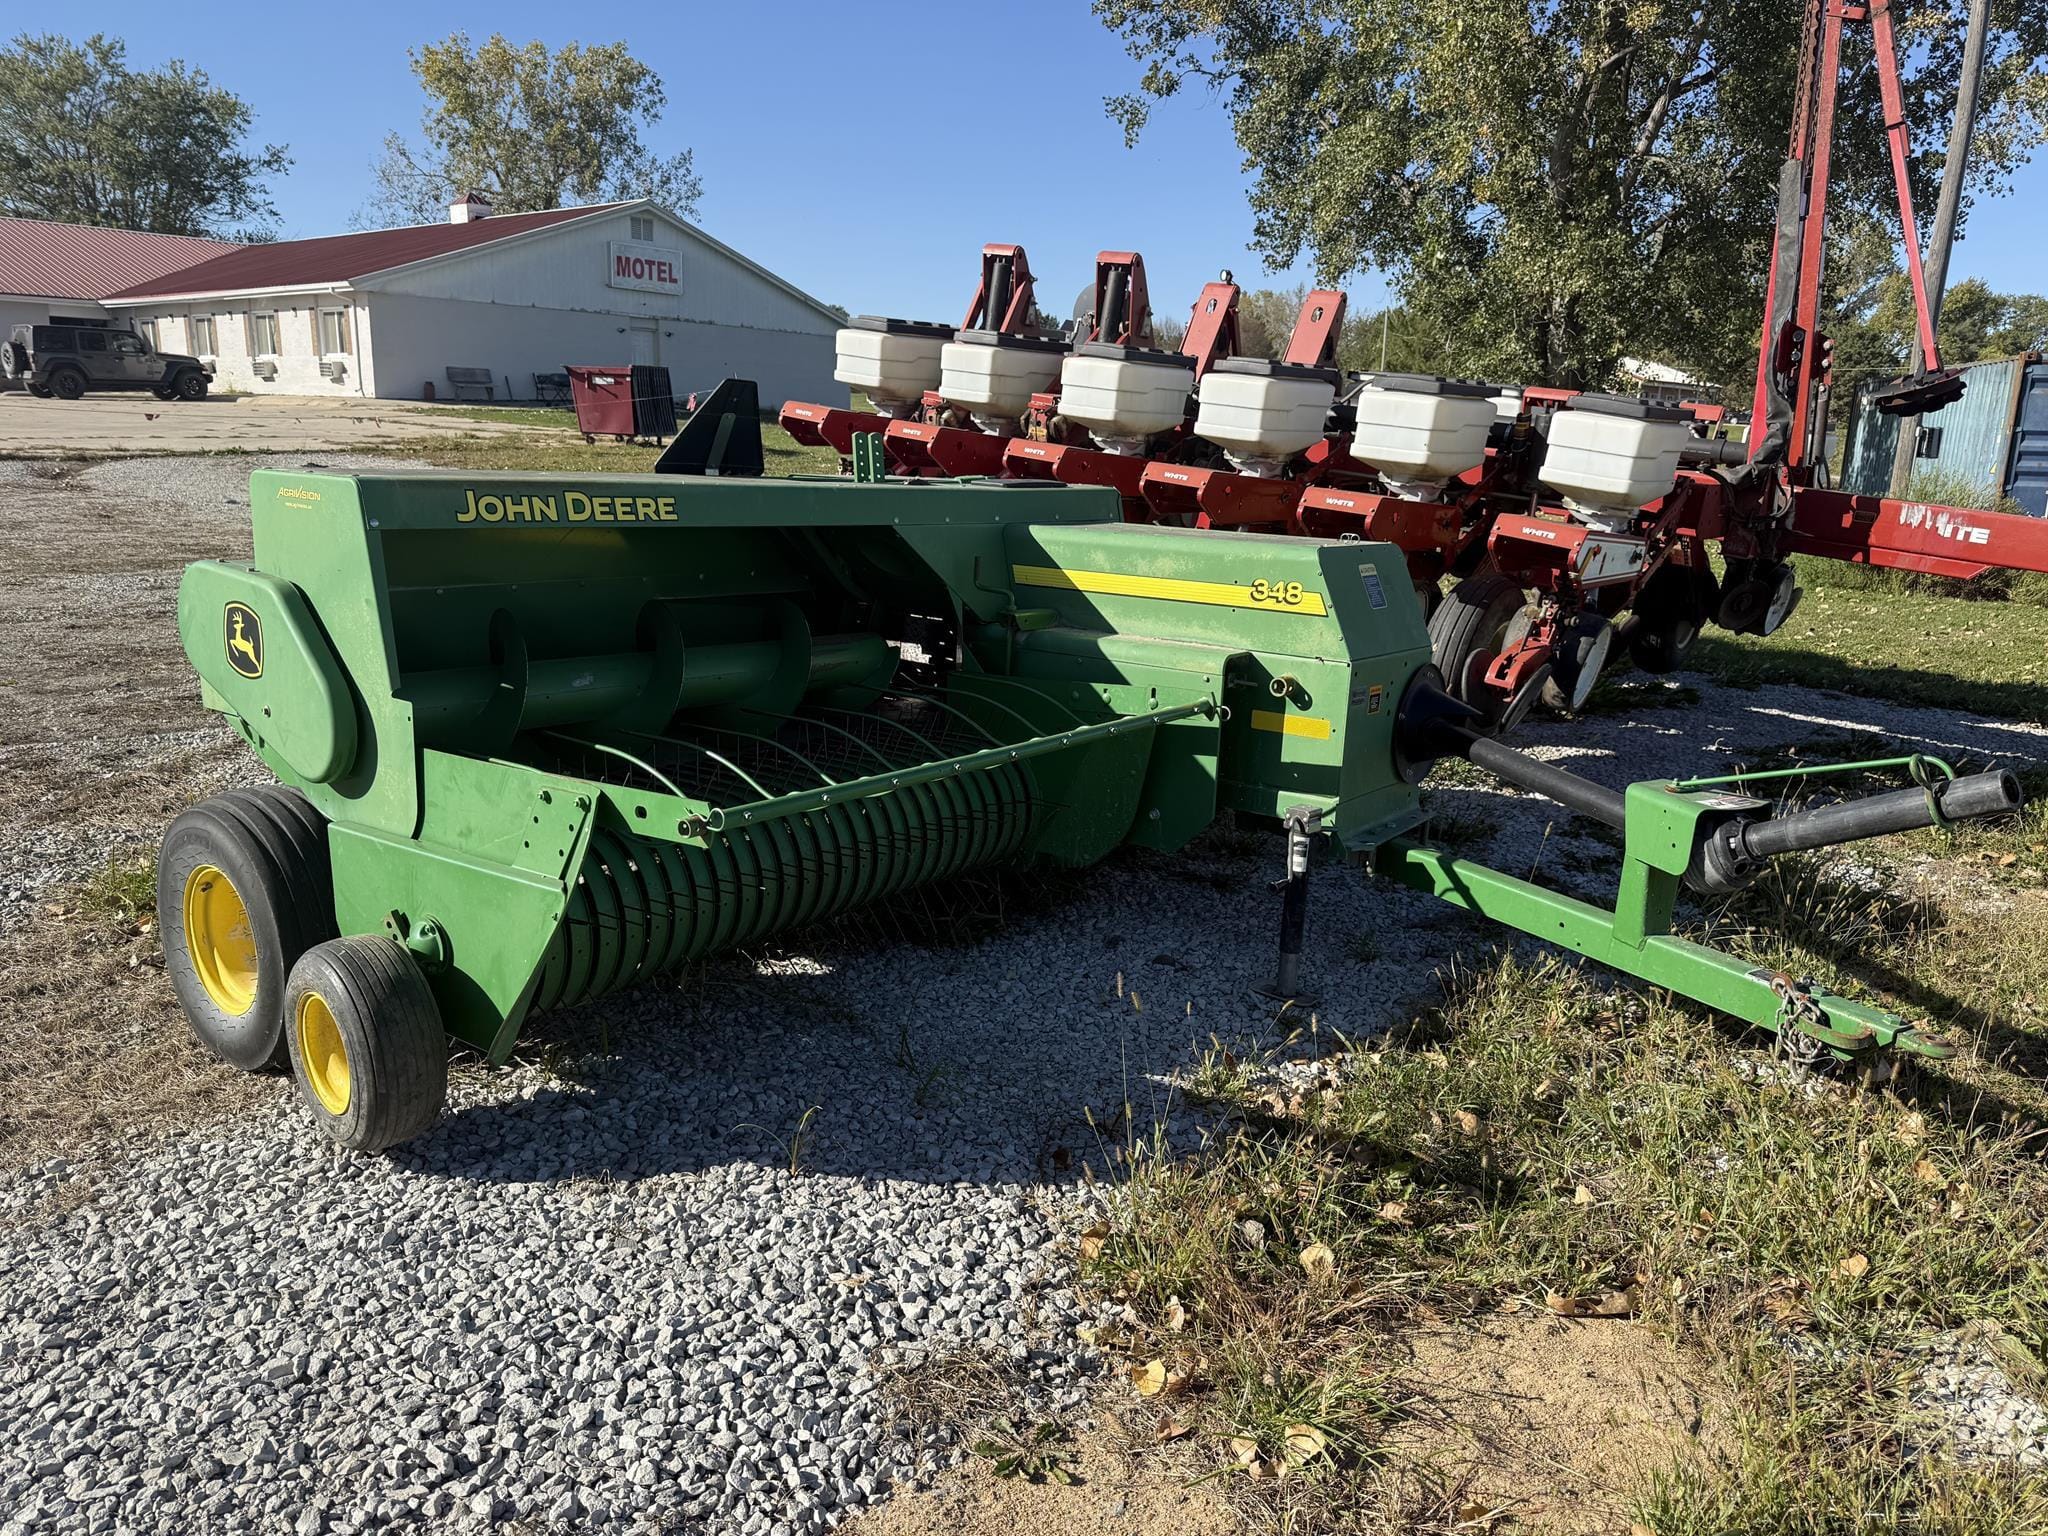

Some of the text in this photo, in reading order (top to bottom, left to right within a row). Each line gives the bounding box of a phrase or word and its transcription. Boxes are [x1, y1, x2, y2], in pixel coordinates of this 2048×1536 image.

[616, 254, 678, 284] MOTEL
[1024, 447, 1047, 456] WHITE
[1164, 471, 1189, 481] WHITE
[276, 485, 321, 501] AGRIVISION
[456, 489, 679, 522] JOHN DEERE
[1325, 497, 1355, 508] WHITE
[1522, 526, 1557, 540] WHITE
[1251, 578, 1304, 605] 348
